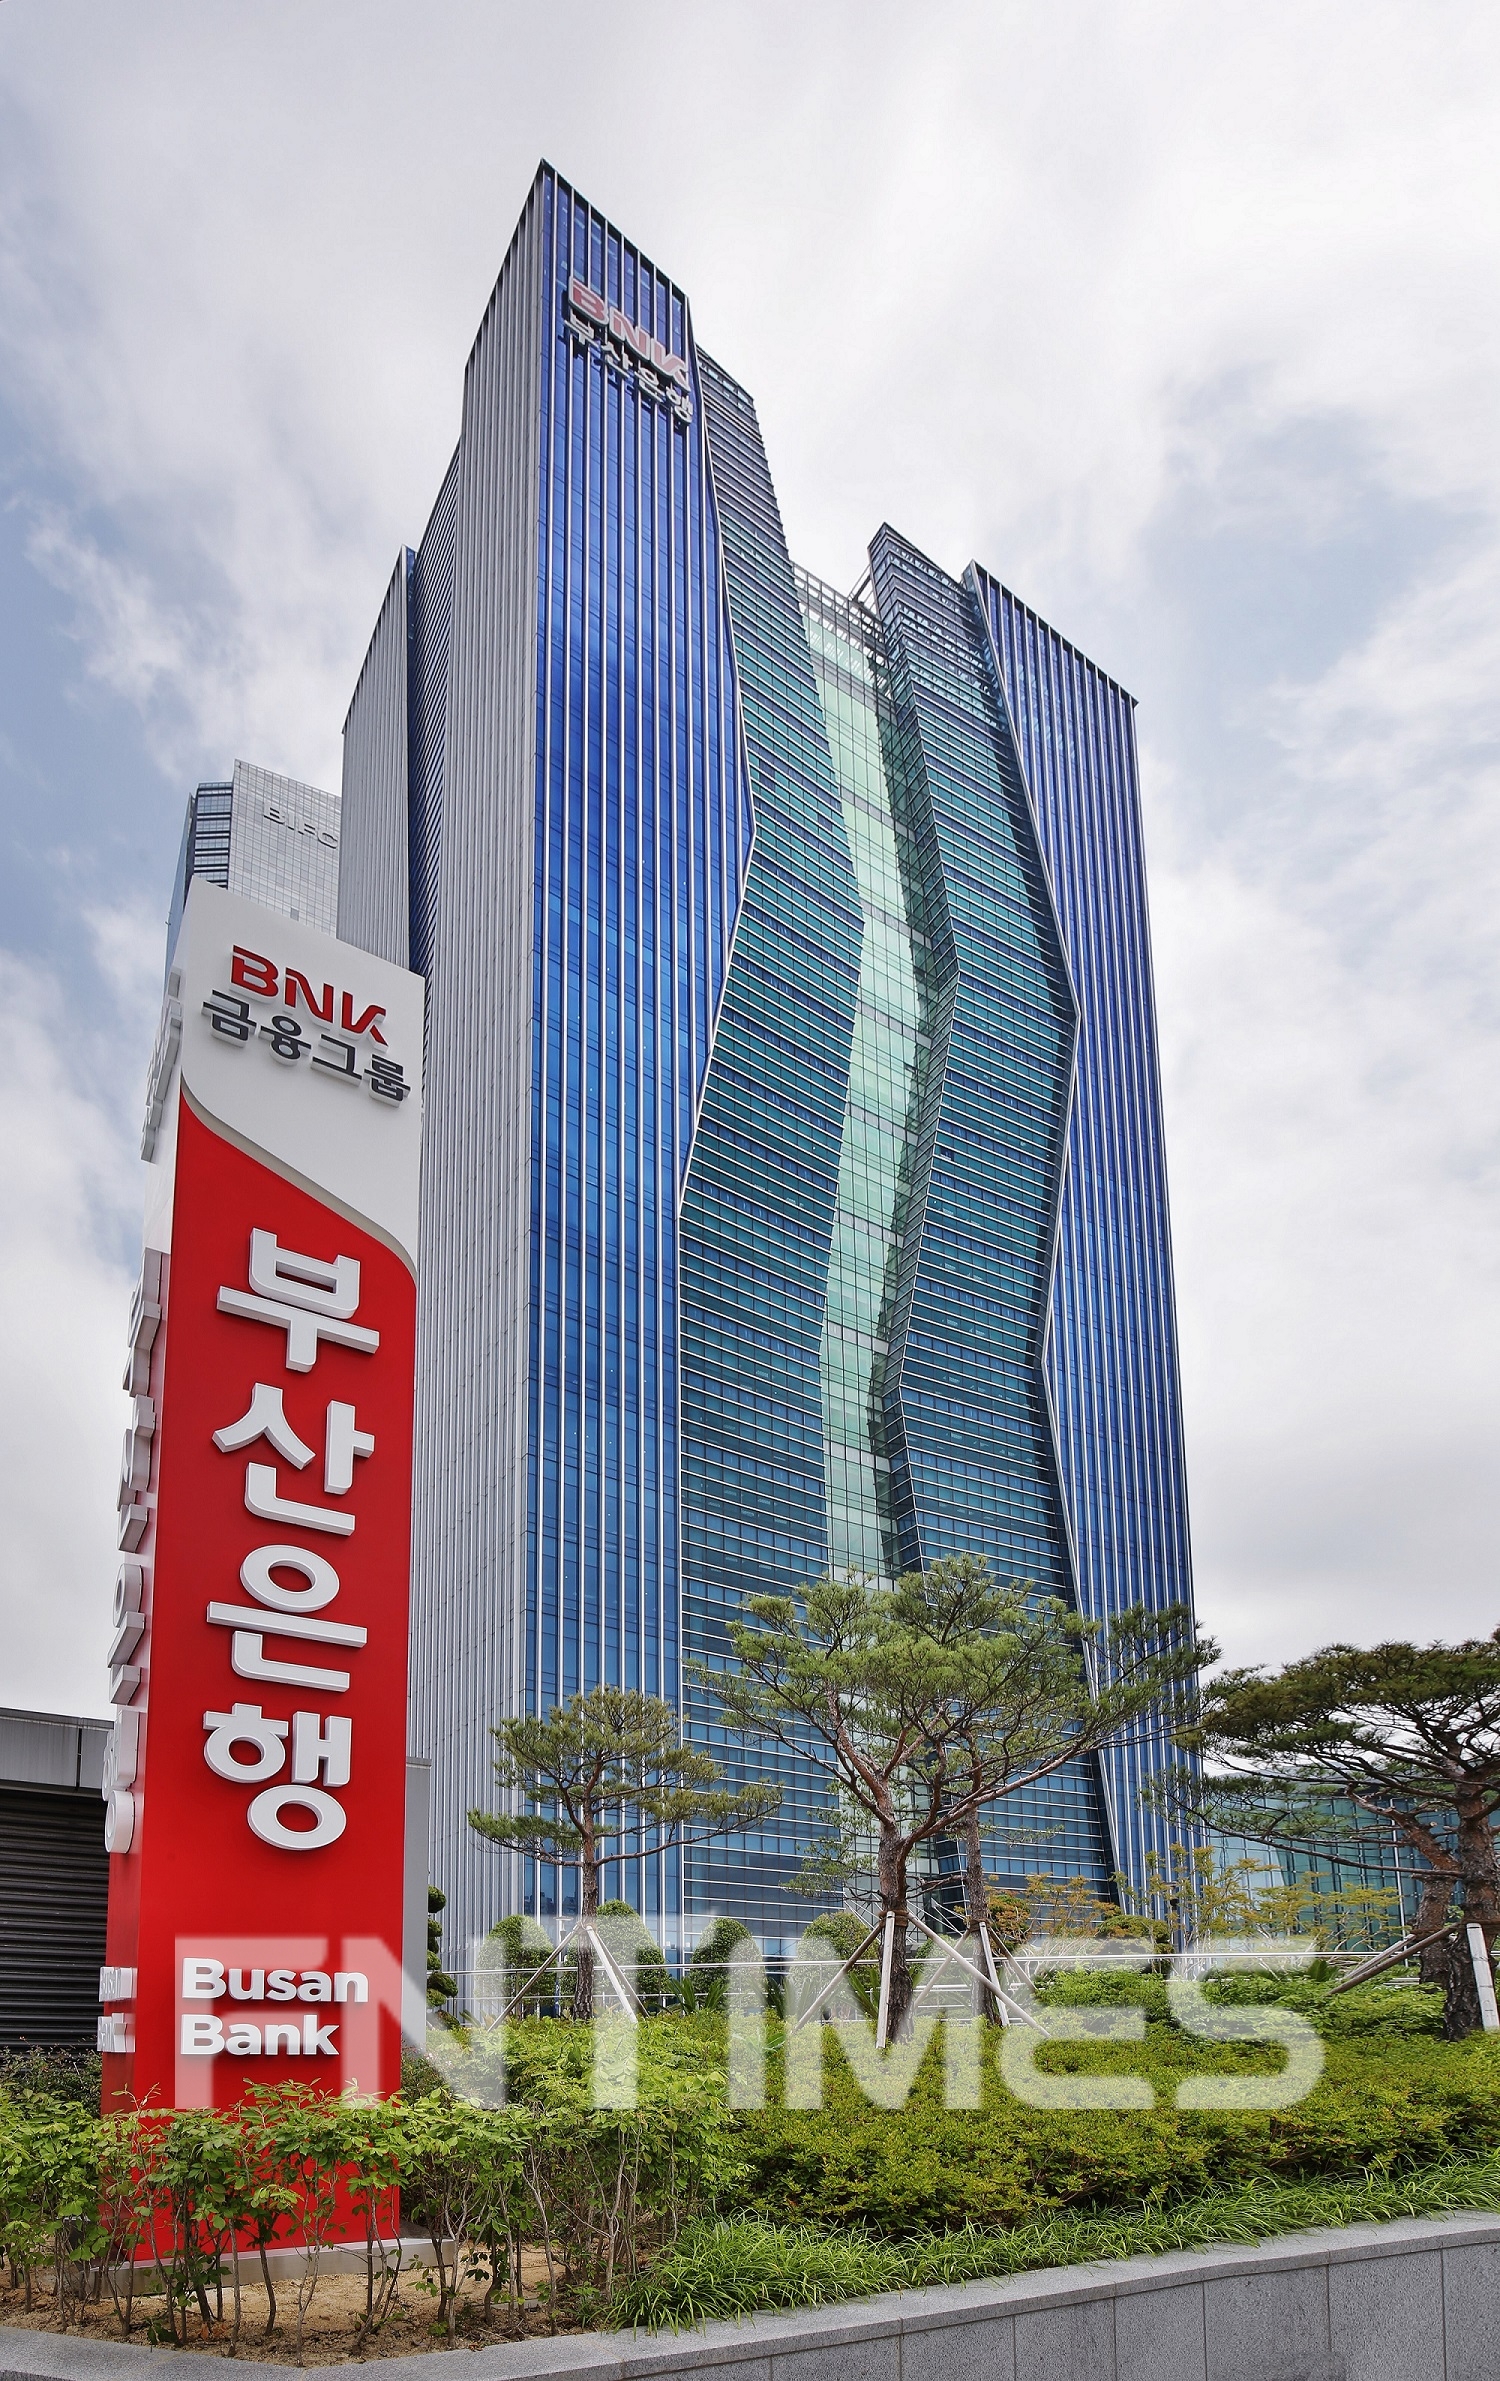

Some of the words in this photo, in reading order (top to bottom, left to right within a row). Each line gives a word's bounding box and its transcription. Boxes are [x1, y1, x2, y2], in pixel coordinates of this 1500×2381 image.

[564, 312, 693, 424] 부산은행
[569, 275, 691, 392] BNK
[262, 802, 339, 849] BIFC
[202, 989, 412, 1108] 금융그룹
[230, 944, 389, 1052] BNK
[202, 1228, 380, 1851] 부산은행
[180, 2012, 340, 2056] Bank
[181, 1956, 370, 2003] Busan
